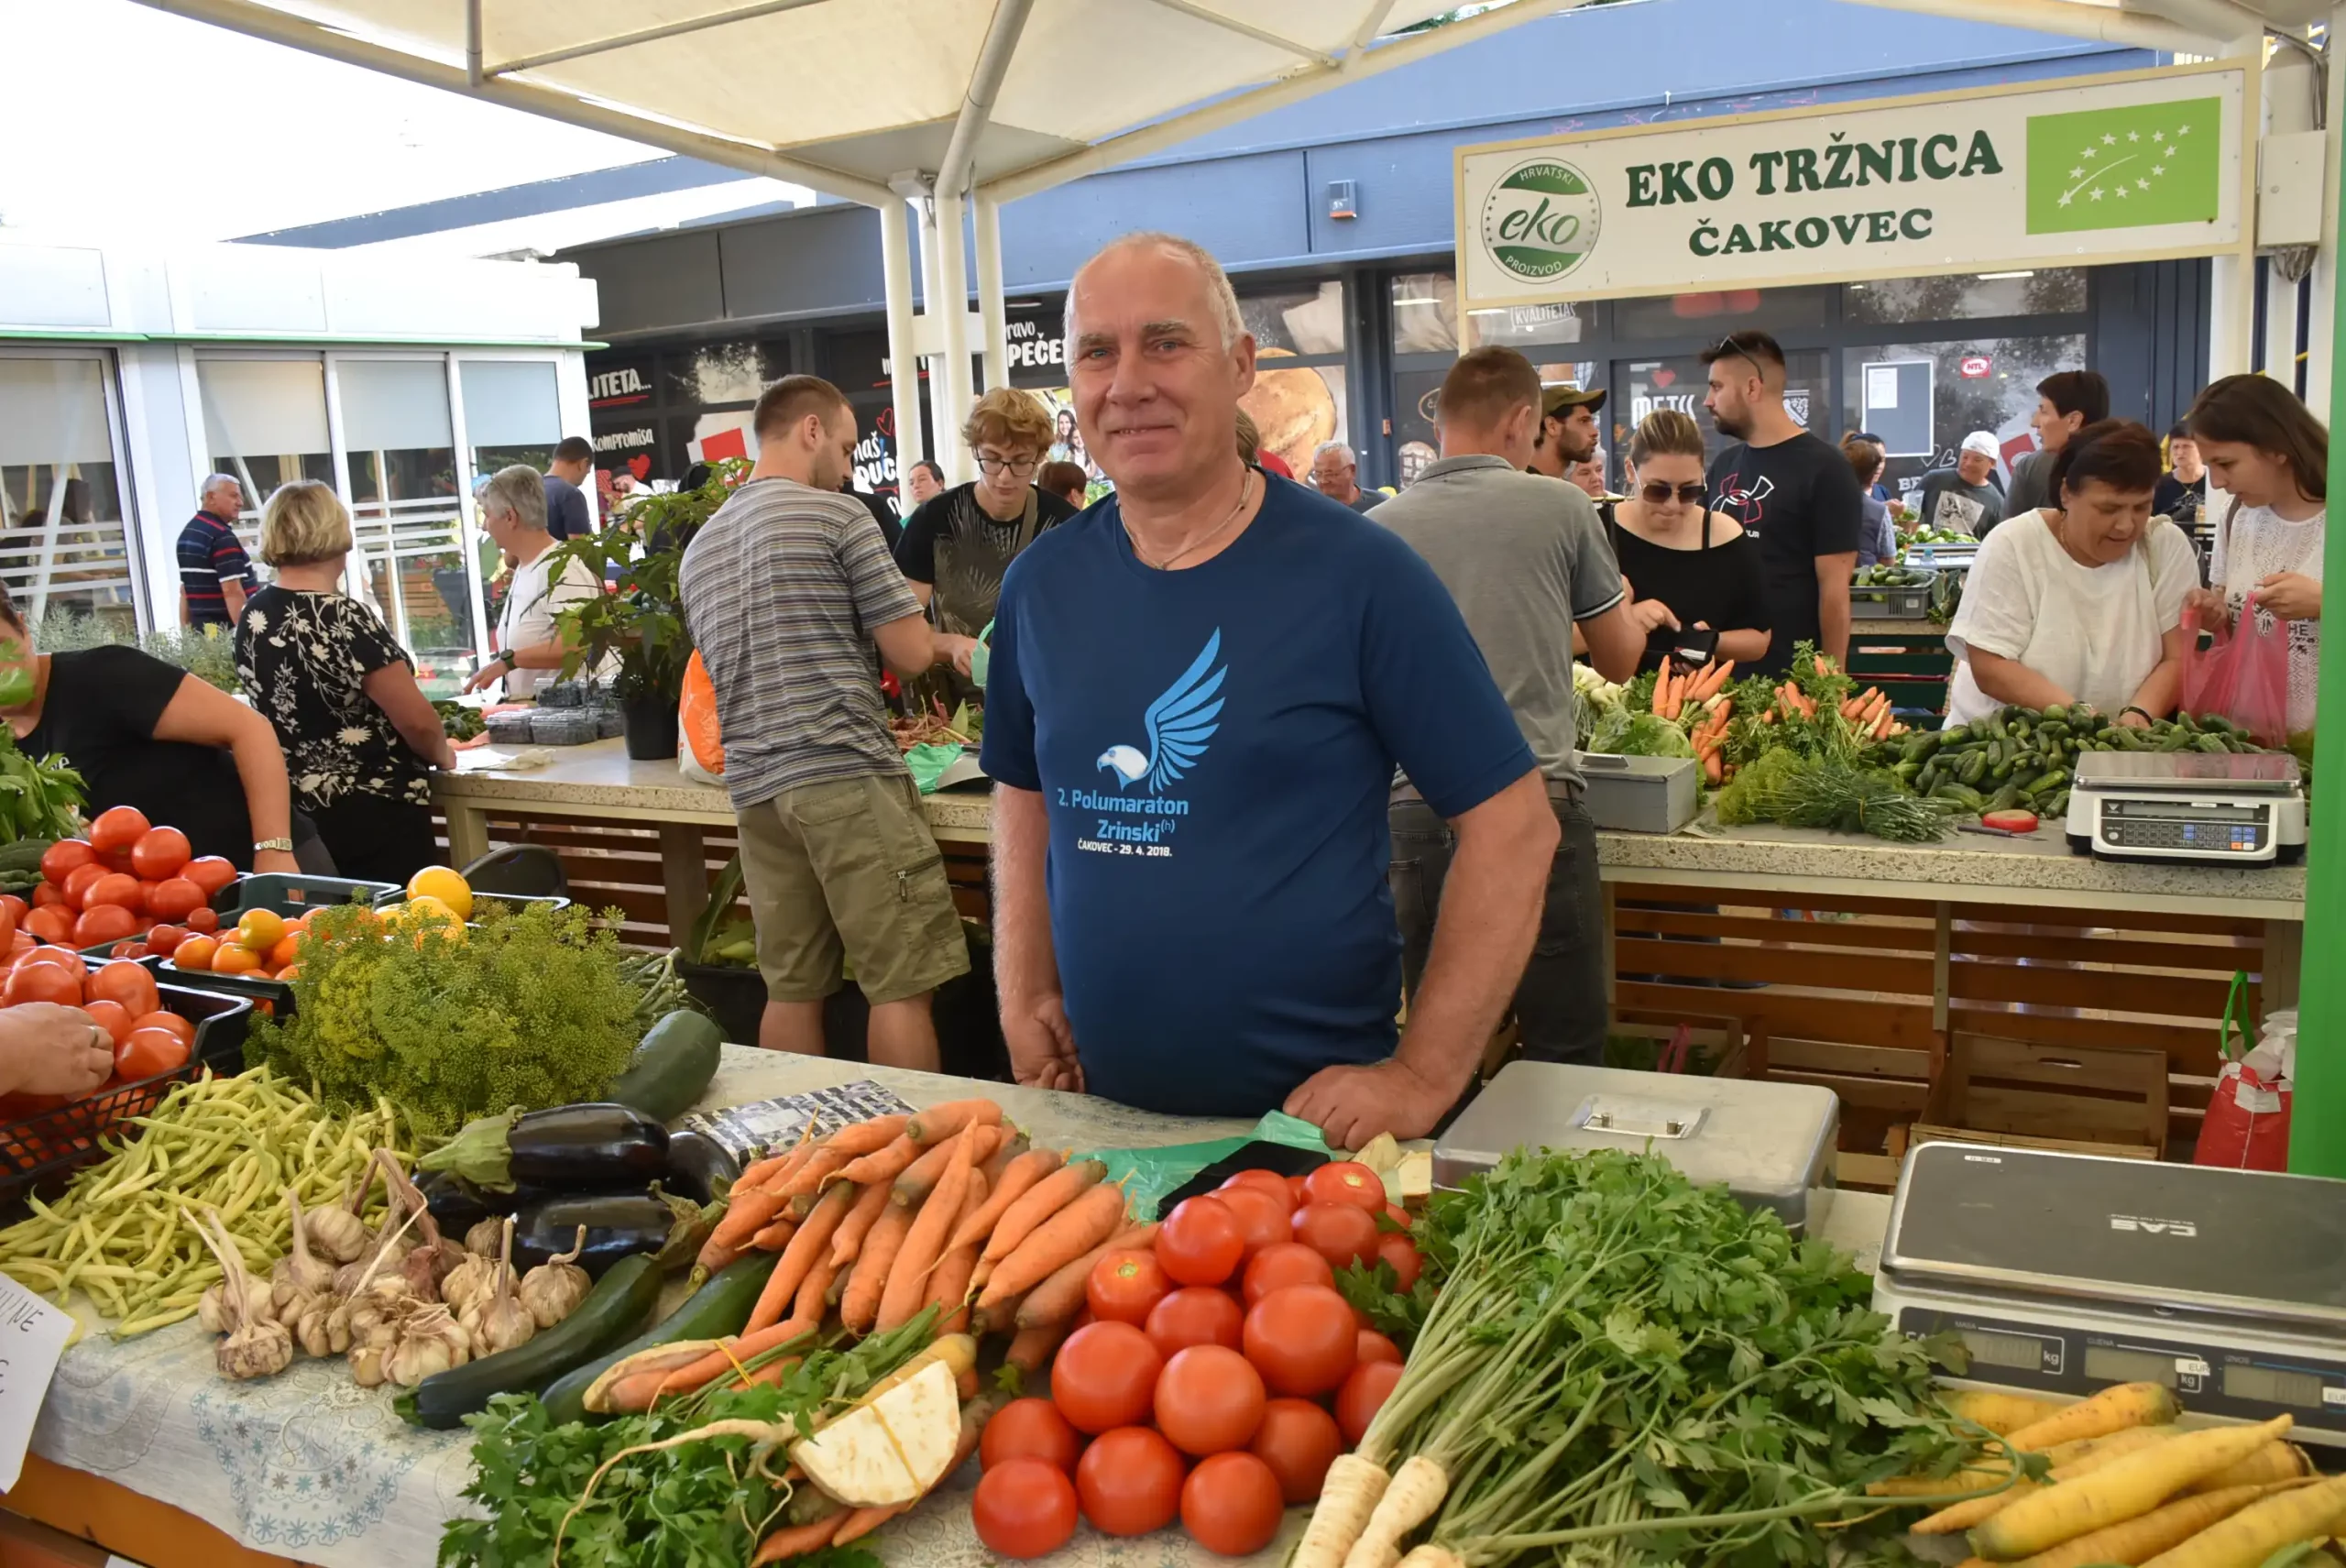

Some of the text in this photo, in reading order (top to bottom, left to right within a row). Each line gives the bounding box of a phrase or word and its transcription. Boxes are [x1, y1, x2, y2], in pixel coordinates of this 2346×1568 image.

[1518, 166, 1575, 186] HRVATSKI
[1625, 129, 2004, 208] EKO TRŽNICA
[1498, 196, 1581, 246] eko
[1688, 207, 1934, 258] ČAKOVEC
[1505, 255, 1562, 276] PROIZVOD
[1007, 332, 1066, 368] PEČE
[1057, 787, 1189, 816] 2. Polumaraton
[1078, 838, 1113, 853] ČAKOVEC
[1119, 844, 1135, 856] 29.
[1135, 845, 1146, 856] 4.
[1146, 845, 1173, 858] 2018.
[2043, 1350, 2059, 1365] kg
[2180, 1374, 2196, 1387] kg
